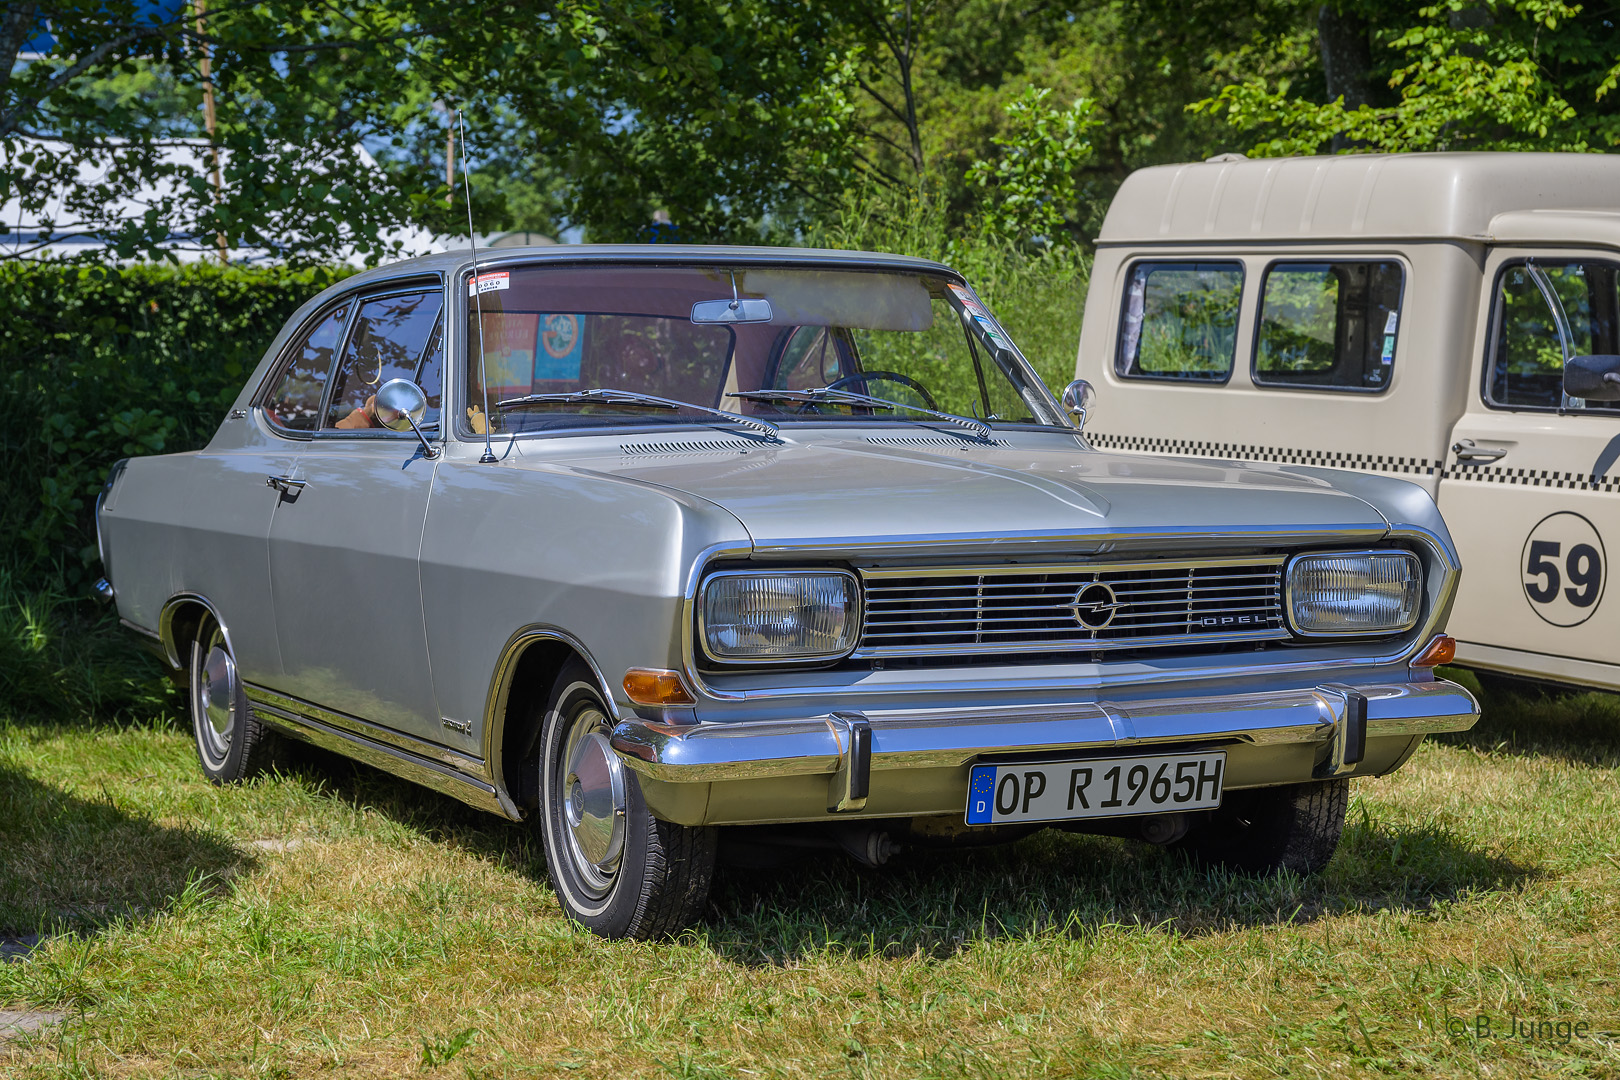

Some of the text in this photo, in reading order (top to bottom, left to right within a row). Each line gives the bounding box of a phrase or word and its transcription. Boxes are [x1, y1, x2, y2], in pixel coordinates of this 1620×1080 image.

[1525, 540, 1602, 608] 59
[1203, 615, 1266, 625] OPEL
[976, 801, 986, 813] D
[995, 771, 1047, 816] OP
